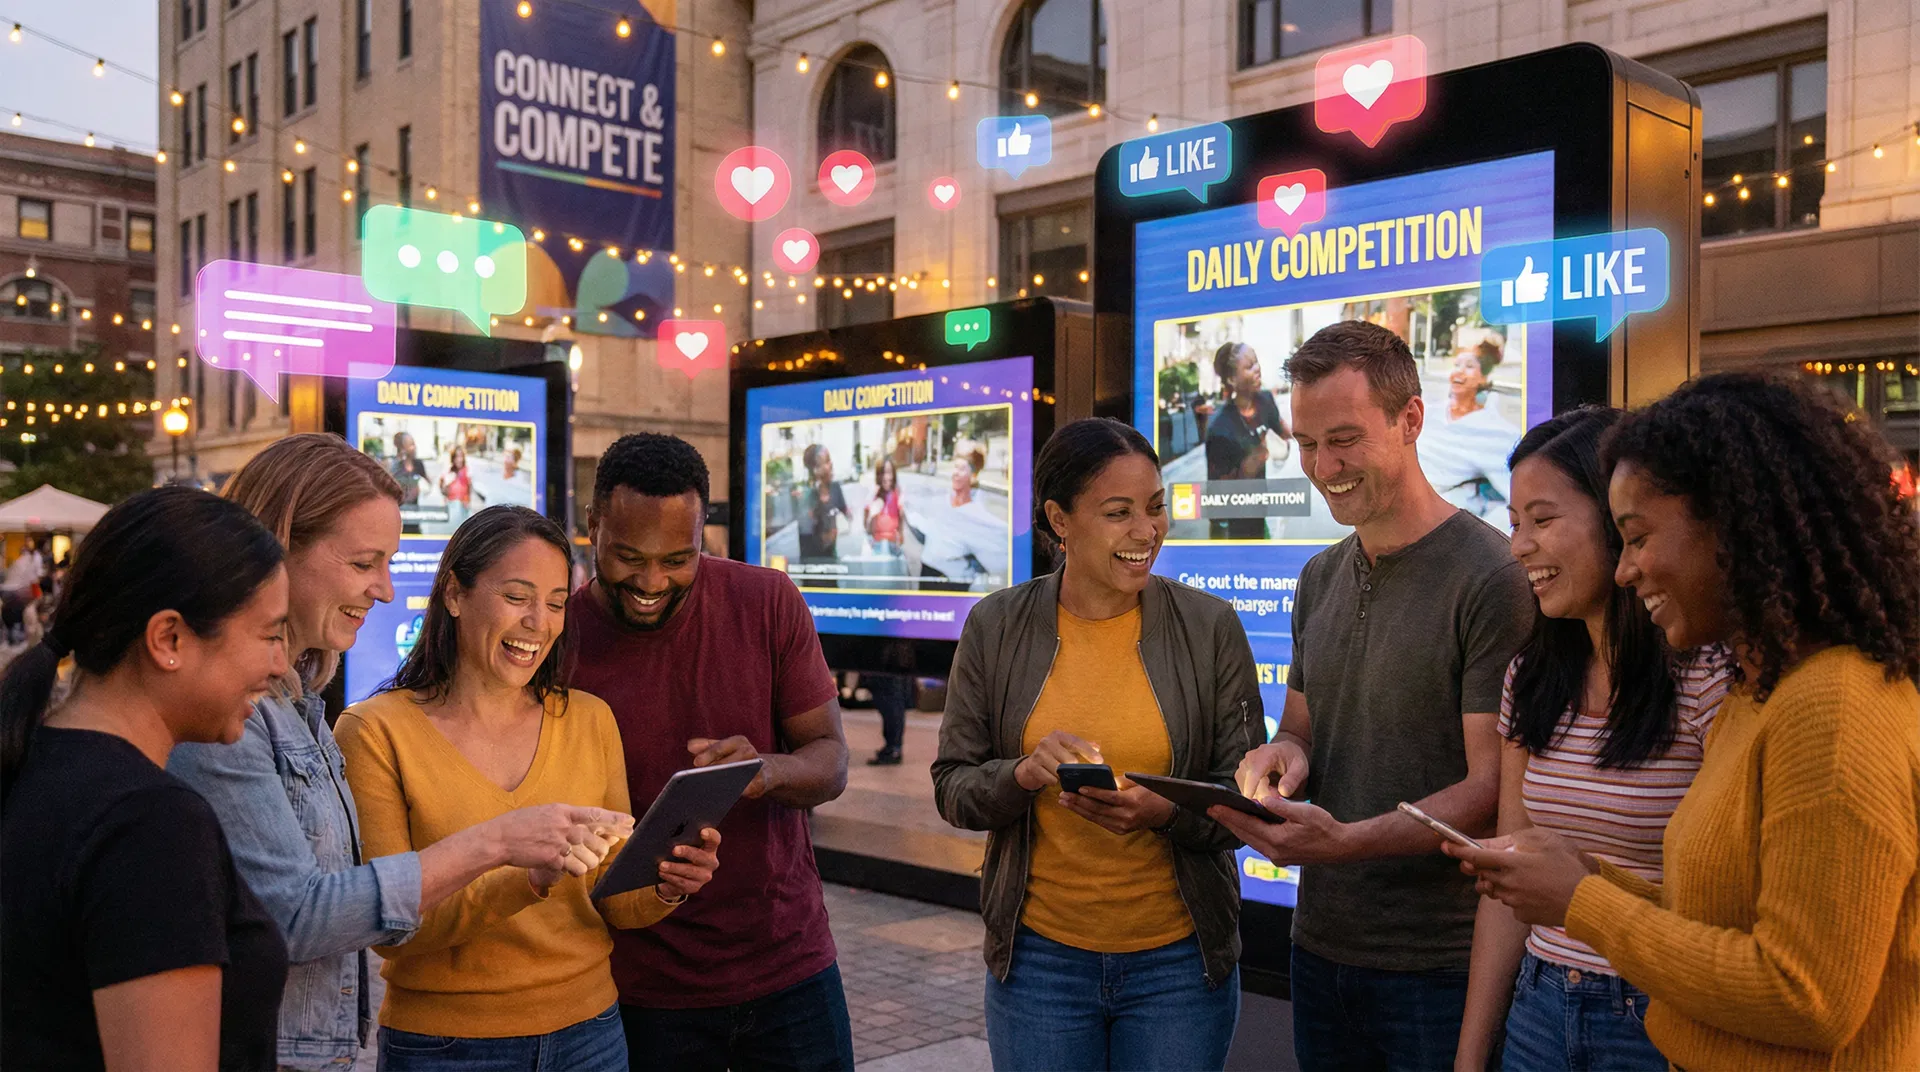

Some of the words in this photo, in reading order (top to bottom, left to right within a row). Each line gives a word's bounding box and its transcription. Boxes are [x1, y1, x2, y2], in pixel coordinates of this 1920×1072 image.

[495, 49, 635, 122] CONNECT
[639, 83, 664, 130] &
[494, 100, 664, 184] COMPETE
[1188, 239, 1264, 292] DAILY
[1270, 206, 1482, 281] COMPETITION
[377, 380, 420, 407] DAILY
[422, 382, 519, 413] COMPETITION
[824, 388, 855, 413] DAILY
[855, 380, 934, 411] COMPETITION
[1201, 494, 1229, 506] DAILY
[1231, 492, 1305, 505] COMPETITION
[1208, 574, 1231, 590] out
[1233, 574, 1258, 590] the
